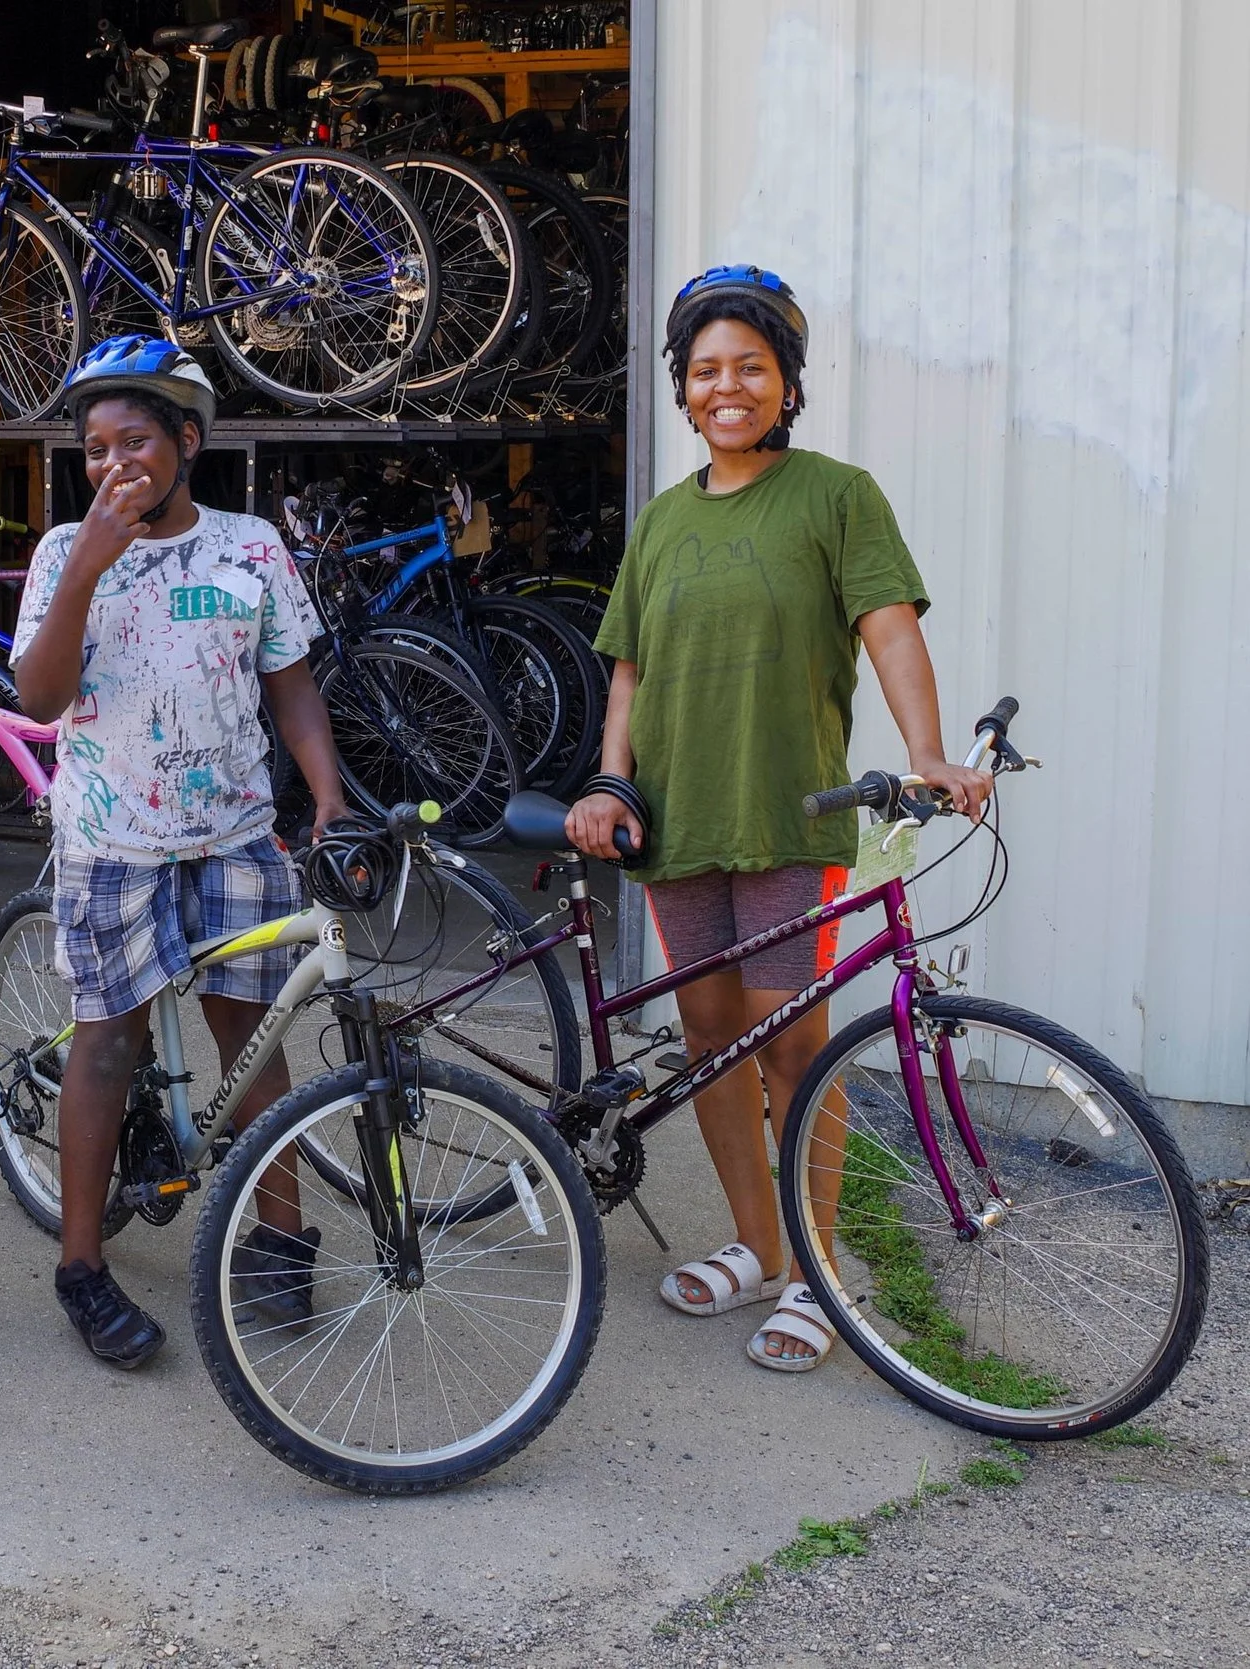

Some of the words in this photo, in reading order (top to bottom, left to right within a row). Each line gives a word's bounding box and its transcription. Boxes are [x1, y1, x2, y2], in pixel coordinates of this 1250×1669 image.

[46, 193, 97, 247] TREK
[195, 1000, 286, 1137] ROADMASTER
[669, 970, 837, 1105] SCHWINN
